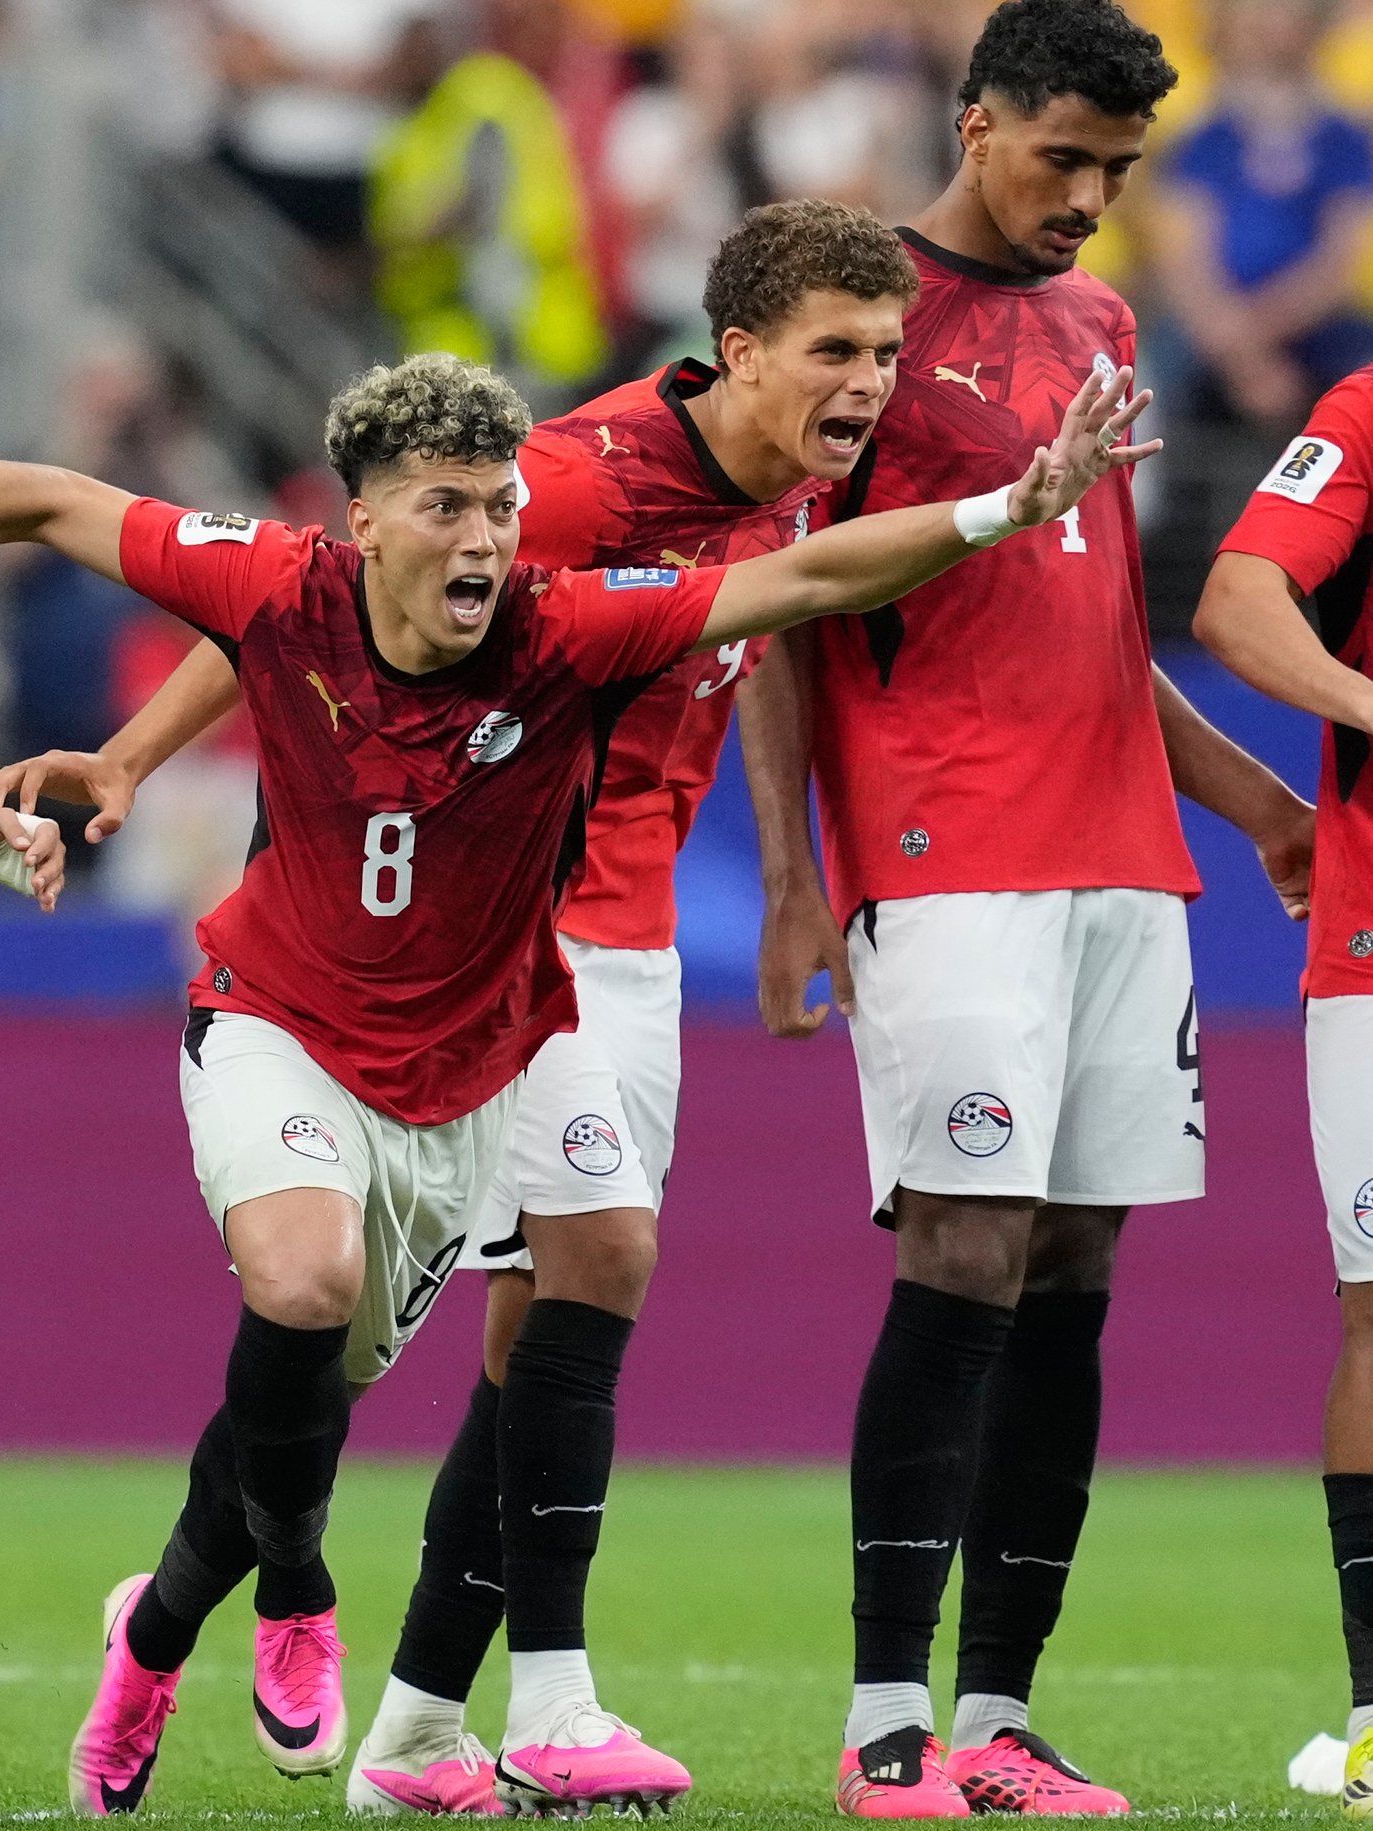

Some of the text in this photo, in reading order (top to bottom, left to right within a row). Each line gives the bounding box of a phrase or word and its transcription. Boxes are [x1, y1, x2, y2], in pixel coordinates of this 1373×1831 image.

[1269, 481, 1298, 494] 2026
[361, 811, 416, 917] 8
[395, 1231, 467, 1328] 8
